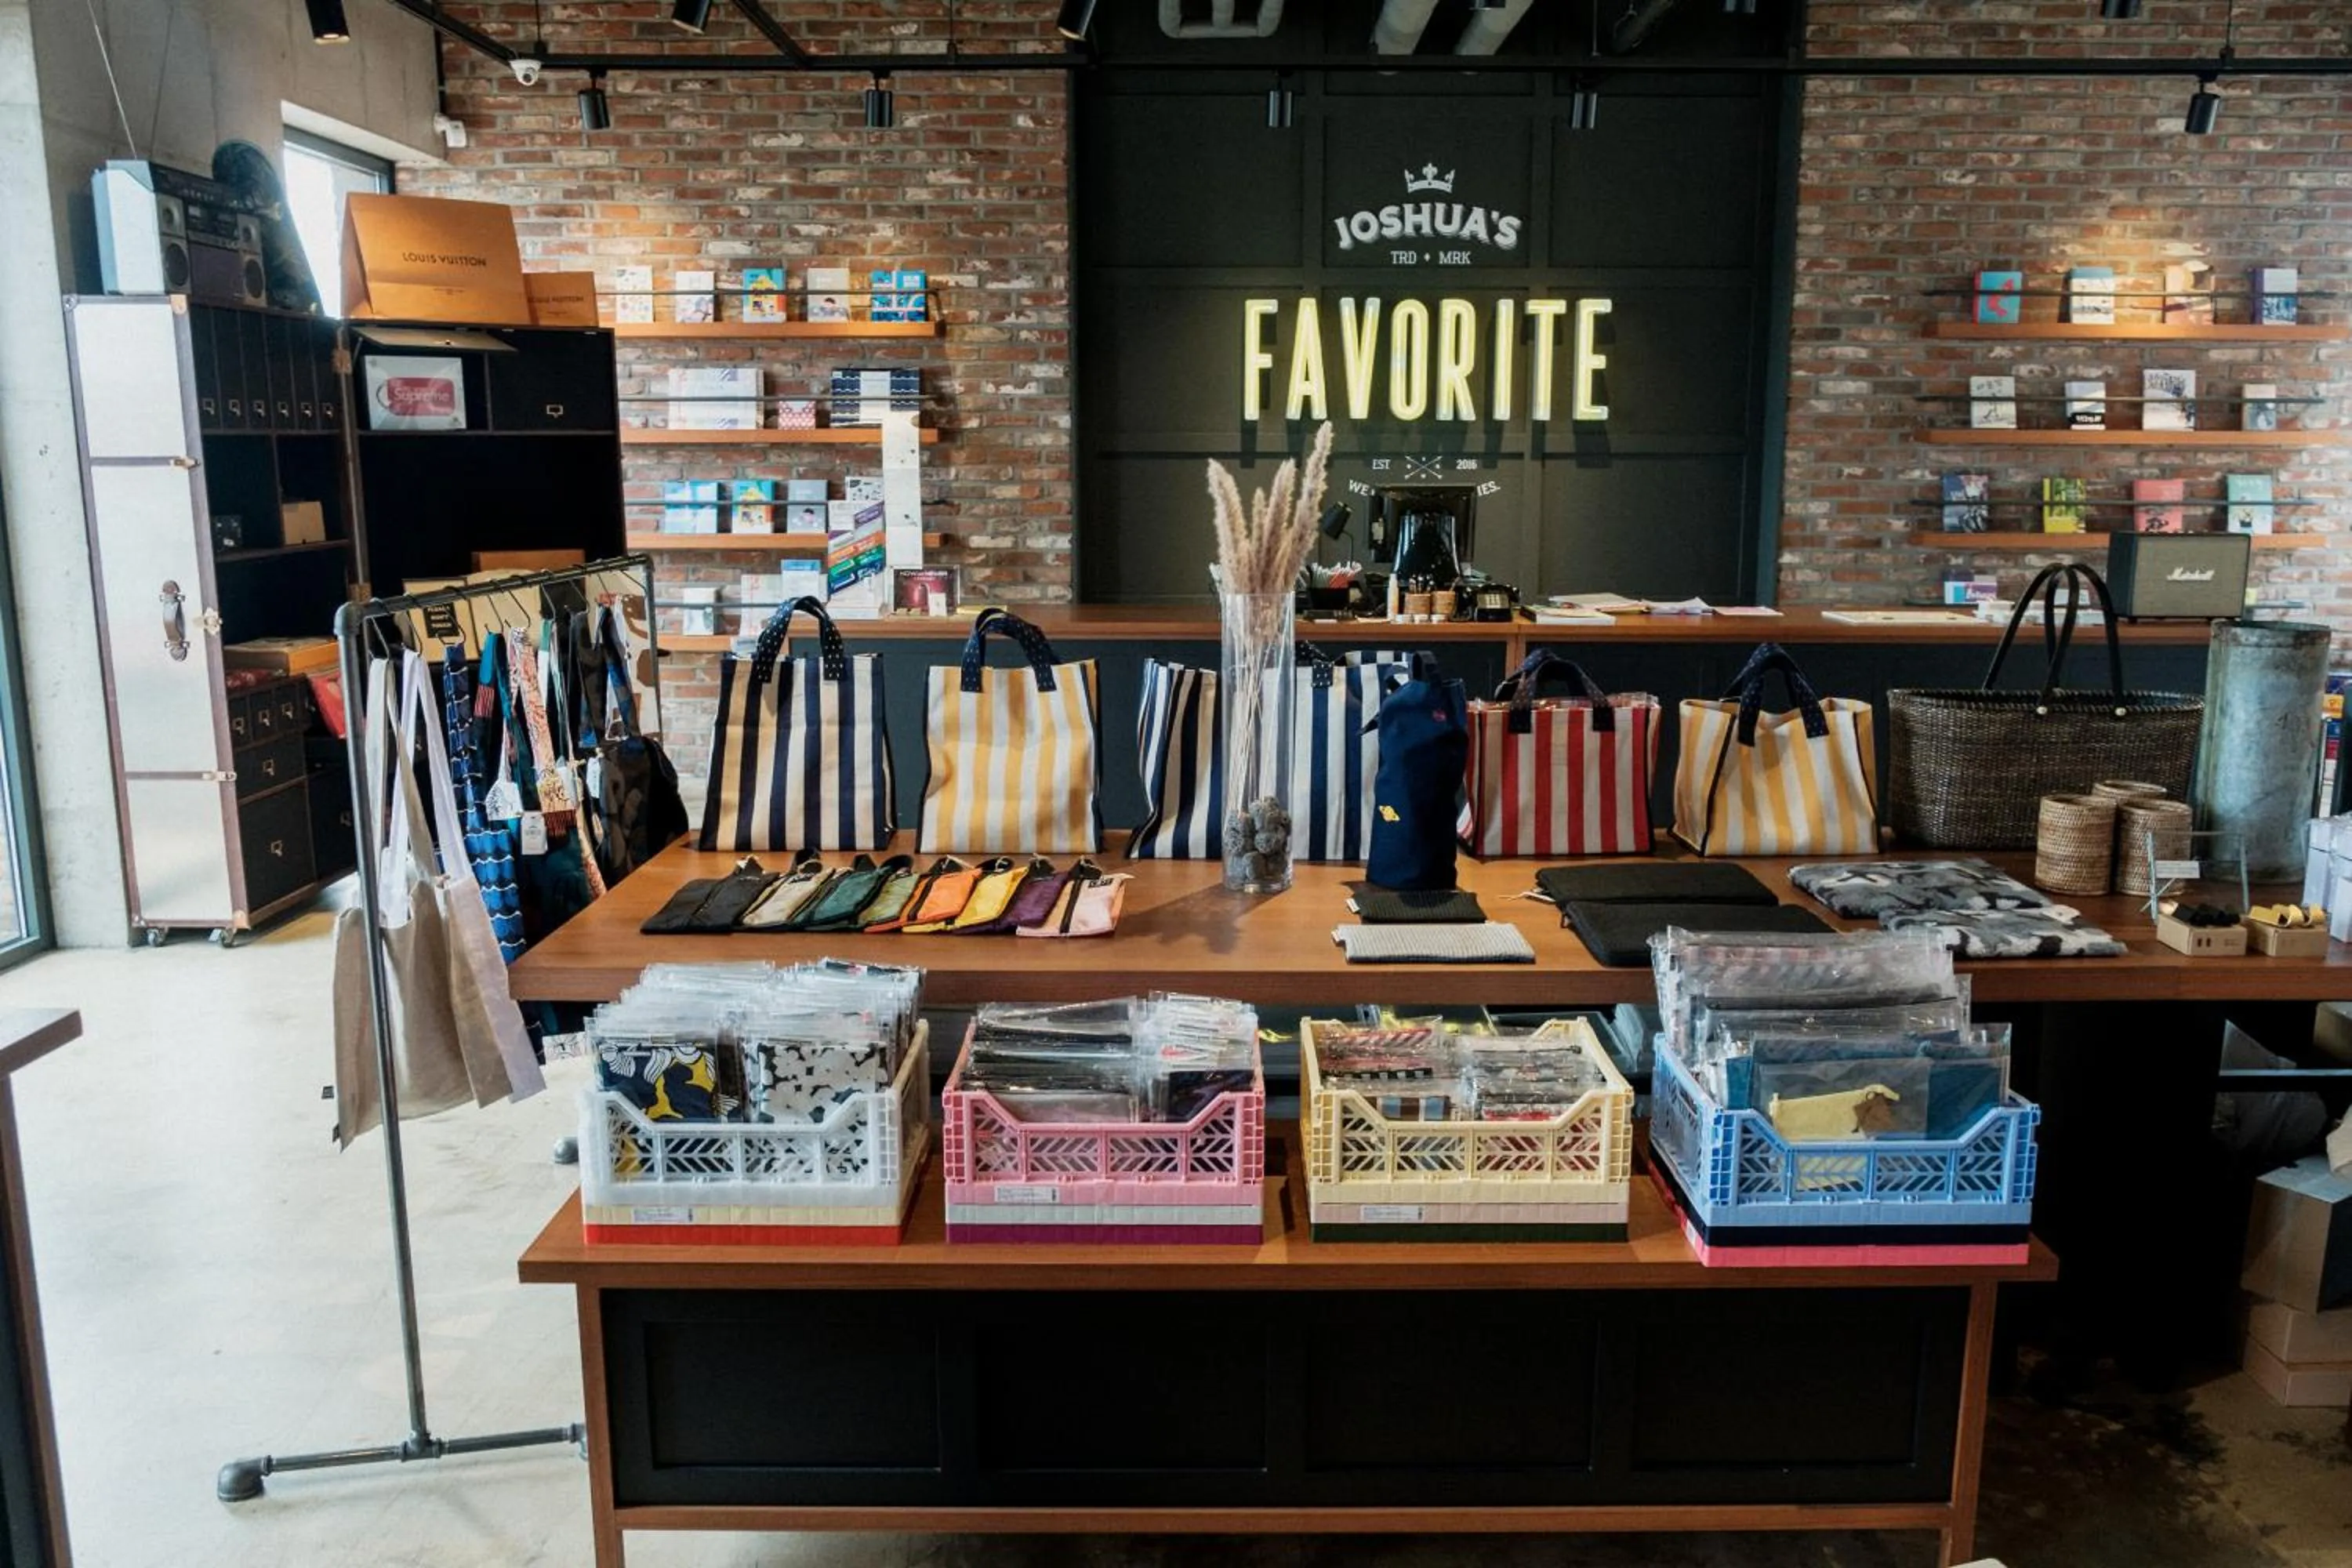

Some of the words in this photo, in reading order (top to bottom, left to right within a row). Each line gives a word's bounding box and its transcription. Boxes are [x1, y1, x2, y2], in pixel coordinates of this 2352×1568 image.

[1334, 201, 1523, 251] JOSHUA'S
[401, 252, 437, 263] LOUIS
[438, 254, 487, 267] VUITTON
[1390, 250, 1417, 264] TRD
[1439, 250, 1471, 264] MRK
[1244, 296, 1613, 421] FAVORITE
[394, 387, 451, 405] Supreme
[1371, 459, 1391, 470] EST
